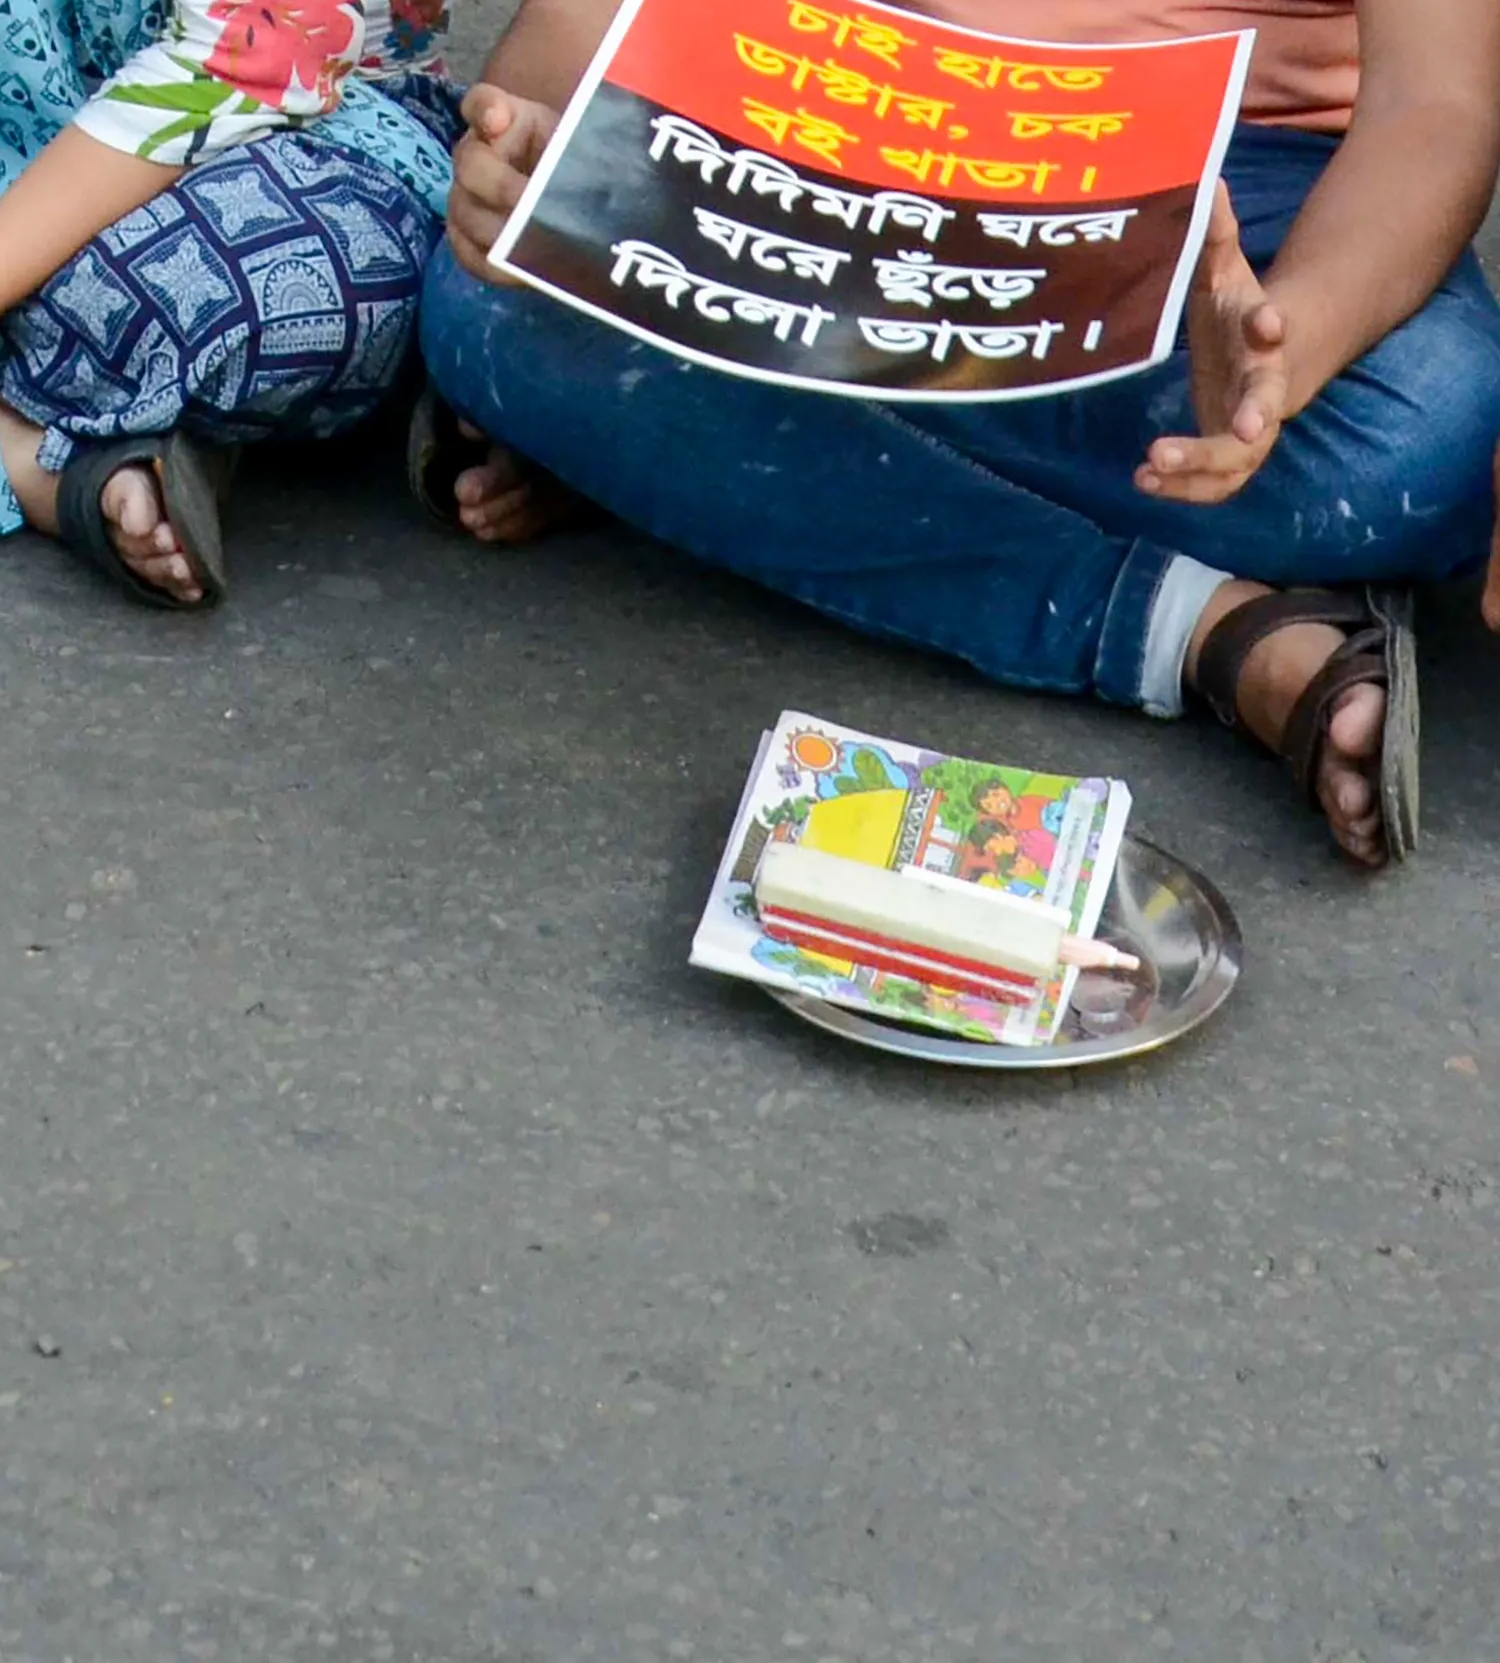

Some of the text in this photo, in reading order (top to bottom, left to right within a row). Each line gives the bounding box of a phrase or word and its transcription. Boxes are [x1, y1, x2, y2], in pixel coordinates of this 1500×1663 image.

[934, 47, 1113, 92] হাতে
[742, 98, 859, 168] বই
[1008, 112, 1131, 140] চক
[649, 115, 1138, 246] দিদিমণি ঘরে
[694, 207, 851, 285] ঘরে
[611, 240, 835, 347] দিলো
